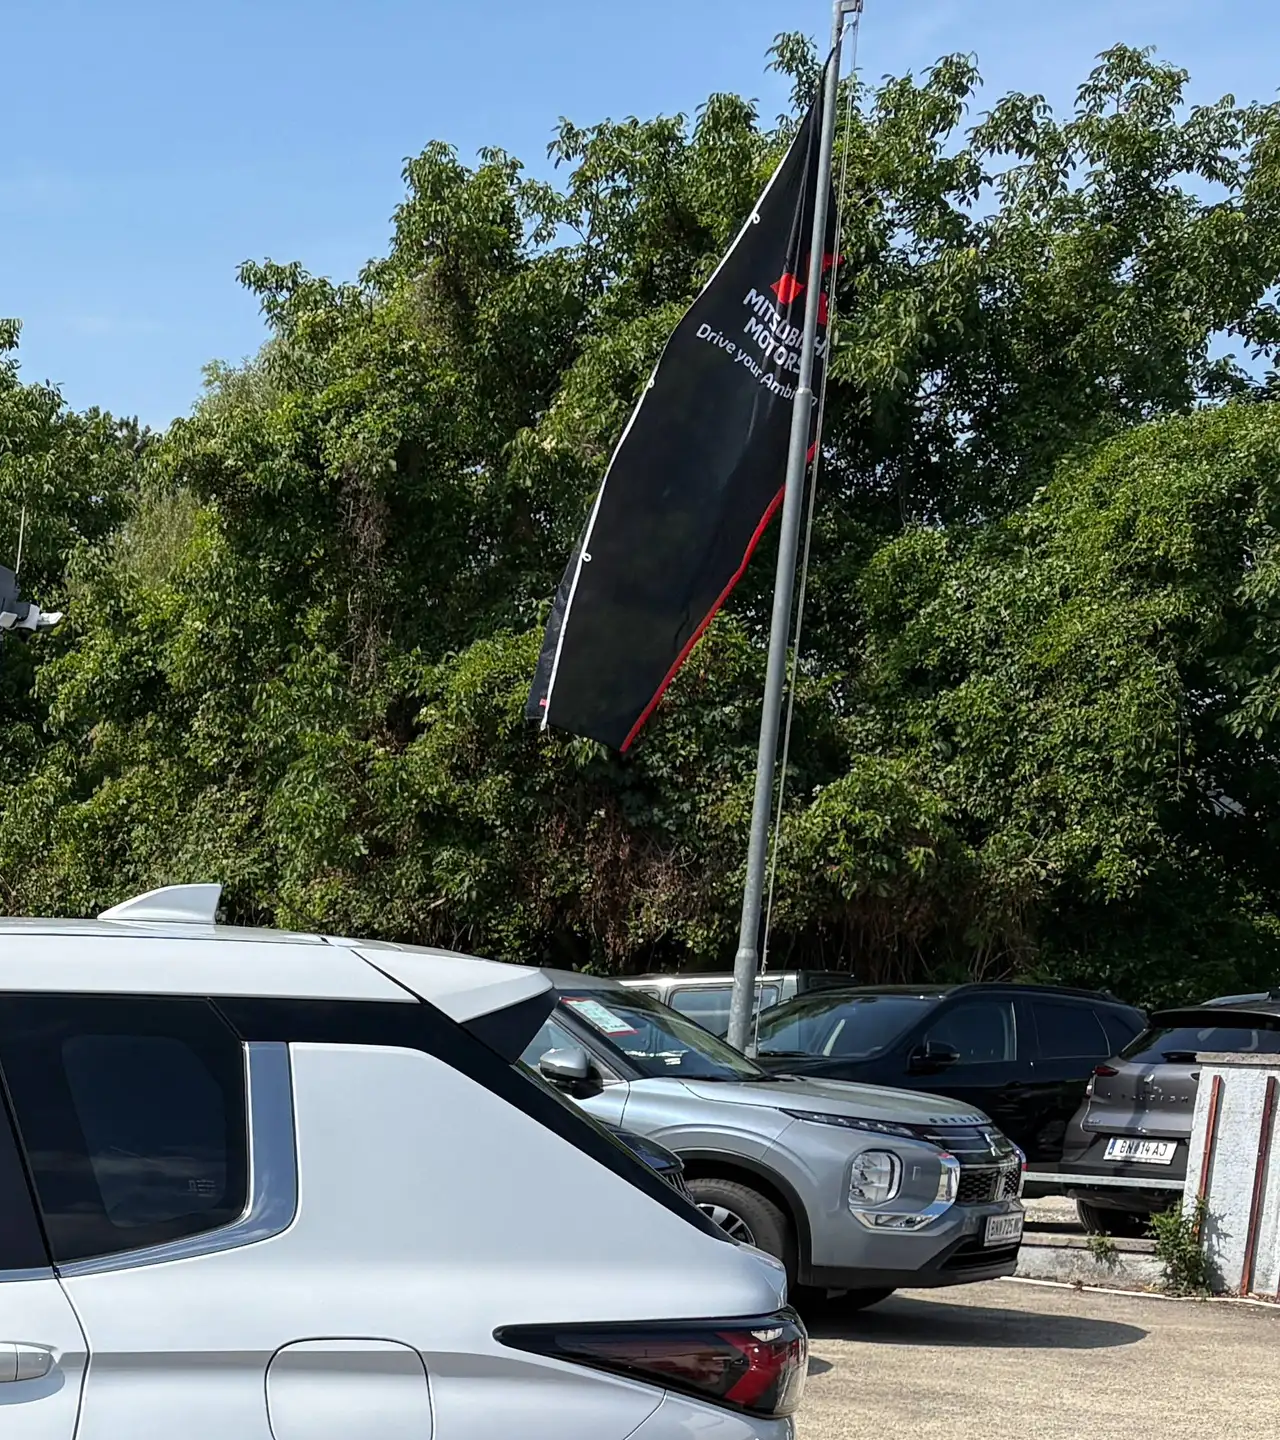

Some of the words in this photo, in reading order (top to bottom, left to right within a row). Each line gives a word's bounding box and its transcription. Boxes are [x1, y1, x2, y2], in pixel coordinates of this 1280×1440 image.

[742, 288, 827, 359] MITSUBIH
[743, 317, 802, 374] MOTORS
[696, 323, 737, 354] Drive
[734, 349, 763, 378] your
[760, 373, 818, 406] Ambi
[1120, 1140, 1135, 1155] BN
